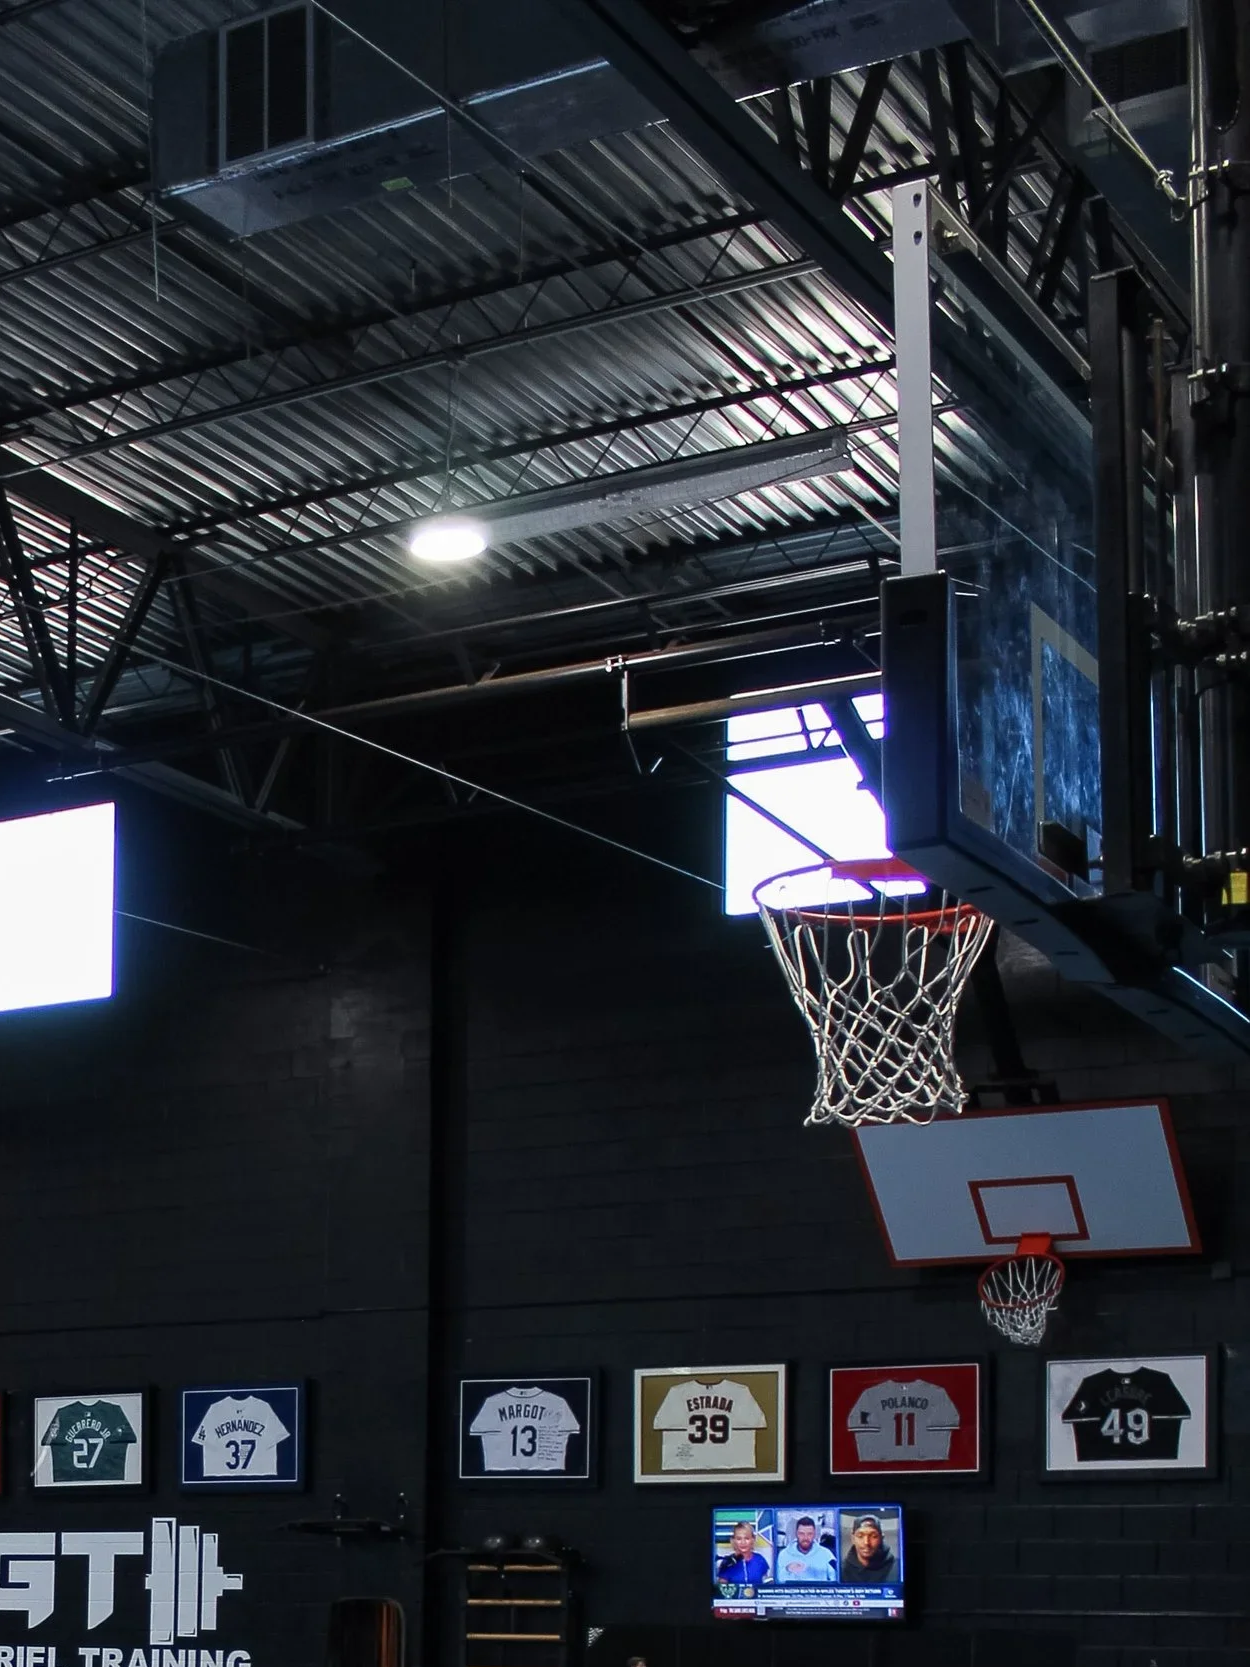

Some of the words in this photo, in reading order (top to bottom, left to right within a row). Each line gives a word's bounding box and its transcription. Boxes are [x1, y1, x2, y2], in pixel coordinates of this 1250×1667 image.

[498, 1404, 546, 1422] MARGOT
[686, 1395, 734, 1413] ESTRADA
[881, 1396, 929, 1410] POLANCO
[65, 1419, 101, 1443] GUERRERO
[215, 1415, 266, 1439] HERNÁNDEZ
[511, 1425, 537, 1457] 13
[688, 1414, 730, 1444] 39
[894, 1412, 916, 1446] 11
[1101, 1408, 1150, 1444] 49
[72, 1438, 104, 1469] 27
[225, 1439, 257, 1470] 37
